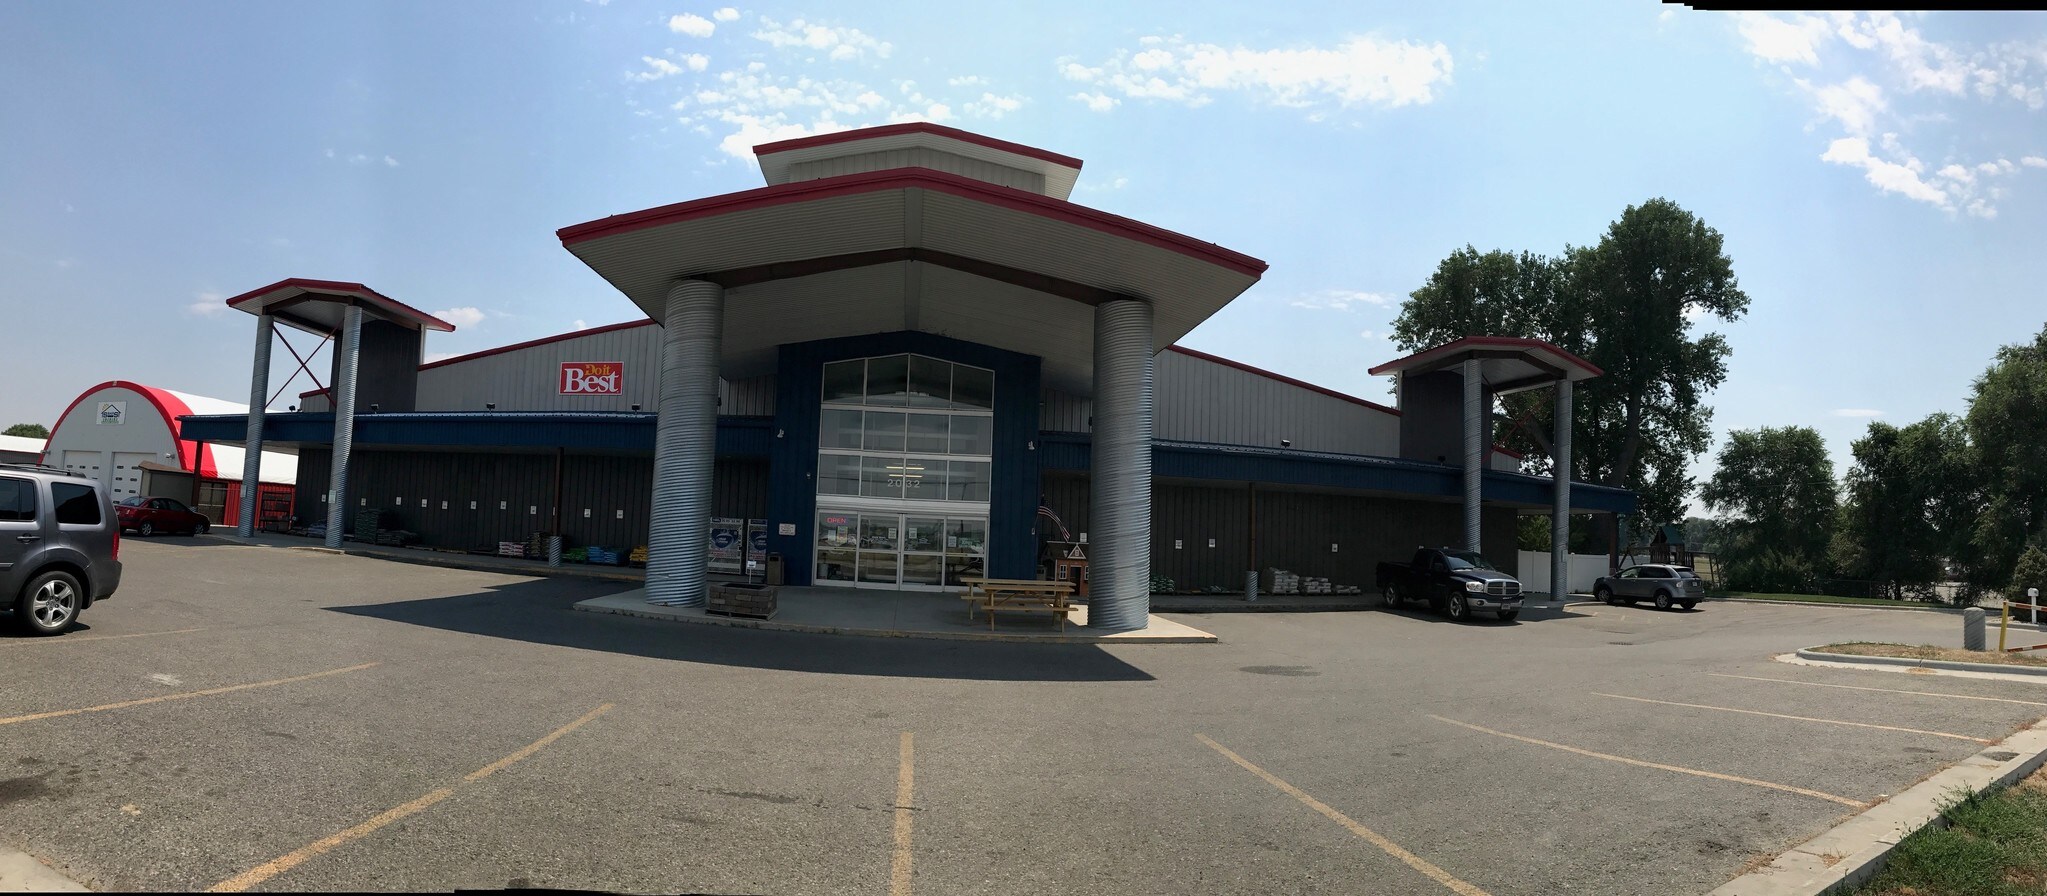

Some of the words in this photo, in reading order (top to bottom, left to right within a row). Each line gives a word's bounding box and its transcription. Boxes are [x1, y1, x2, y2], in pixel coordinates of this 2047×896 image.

[585, 364, 602, 375] Do
[603, 364, 611, 375] it
[564, 368, 619, 392] Best
[888, 479, 920, 488] 2032
